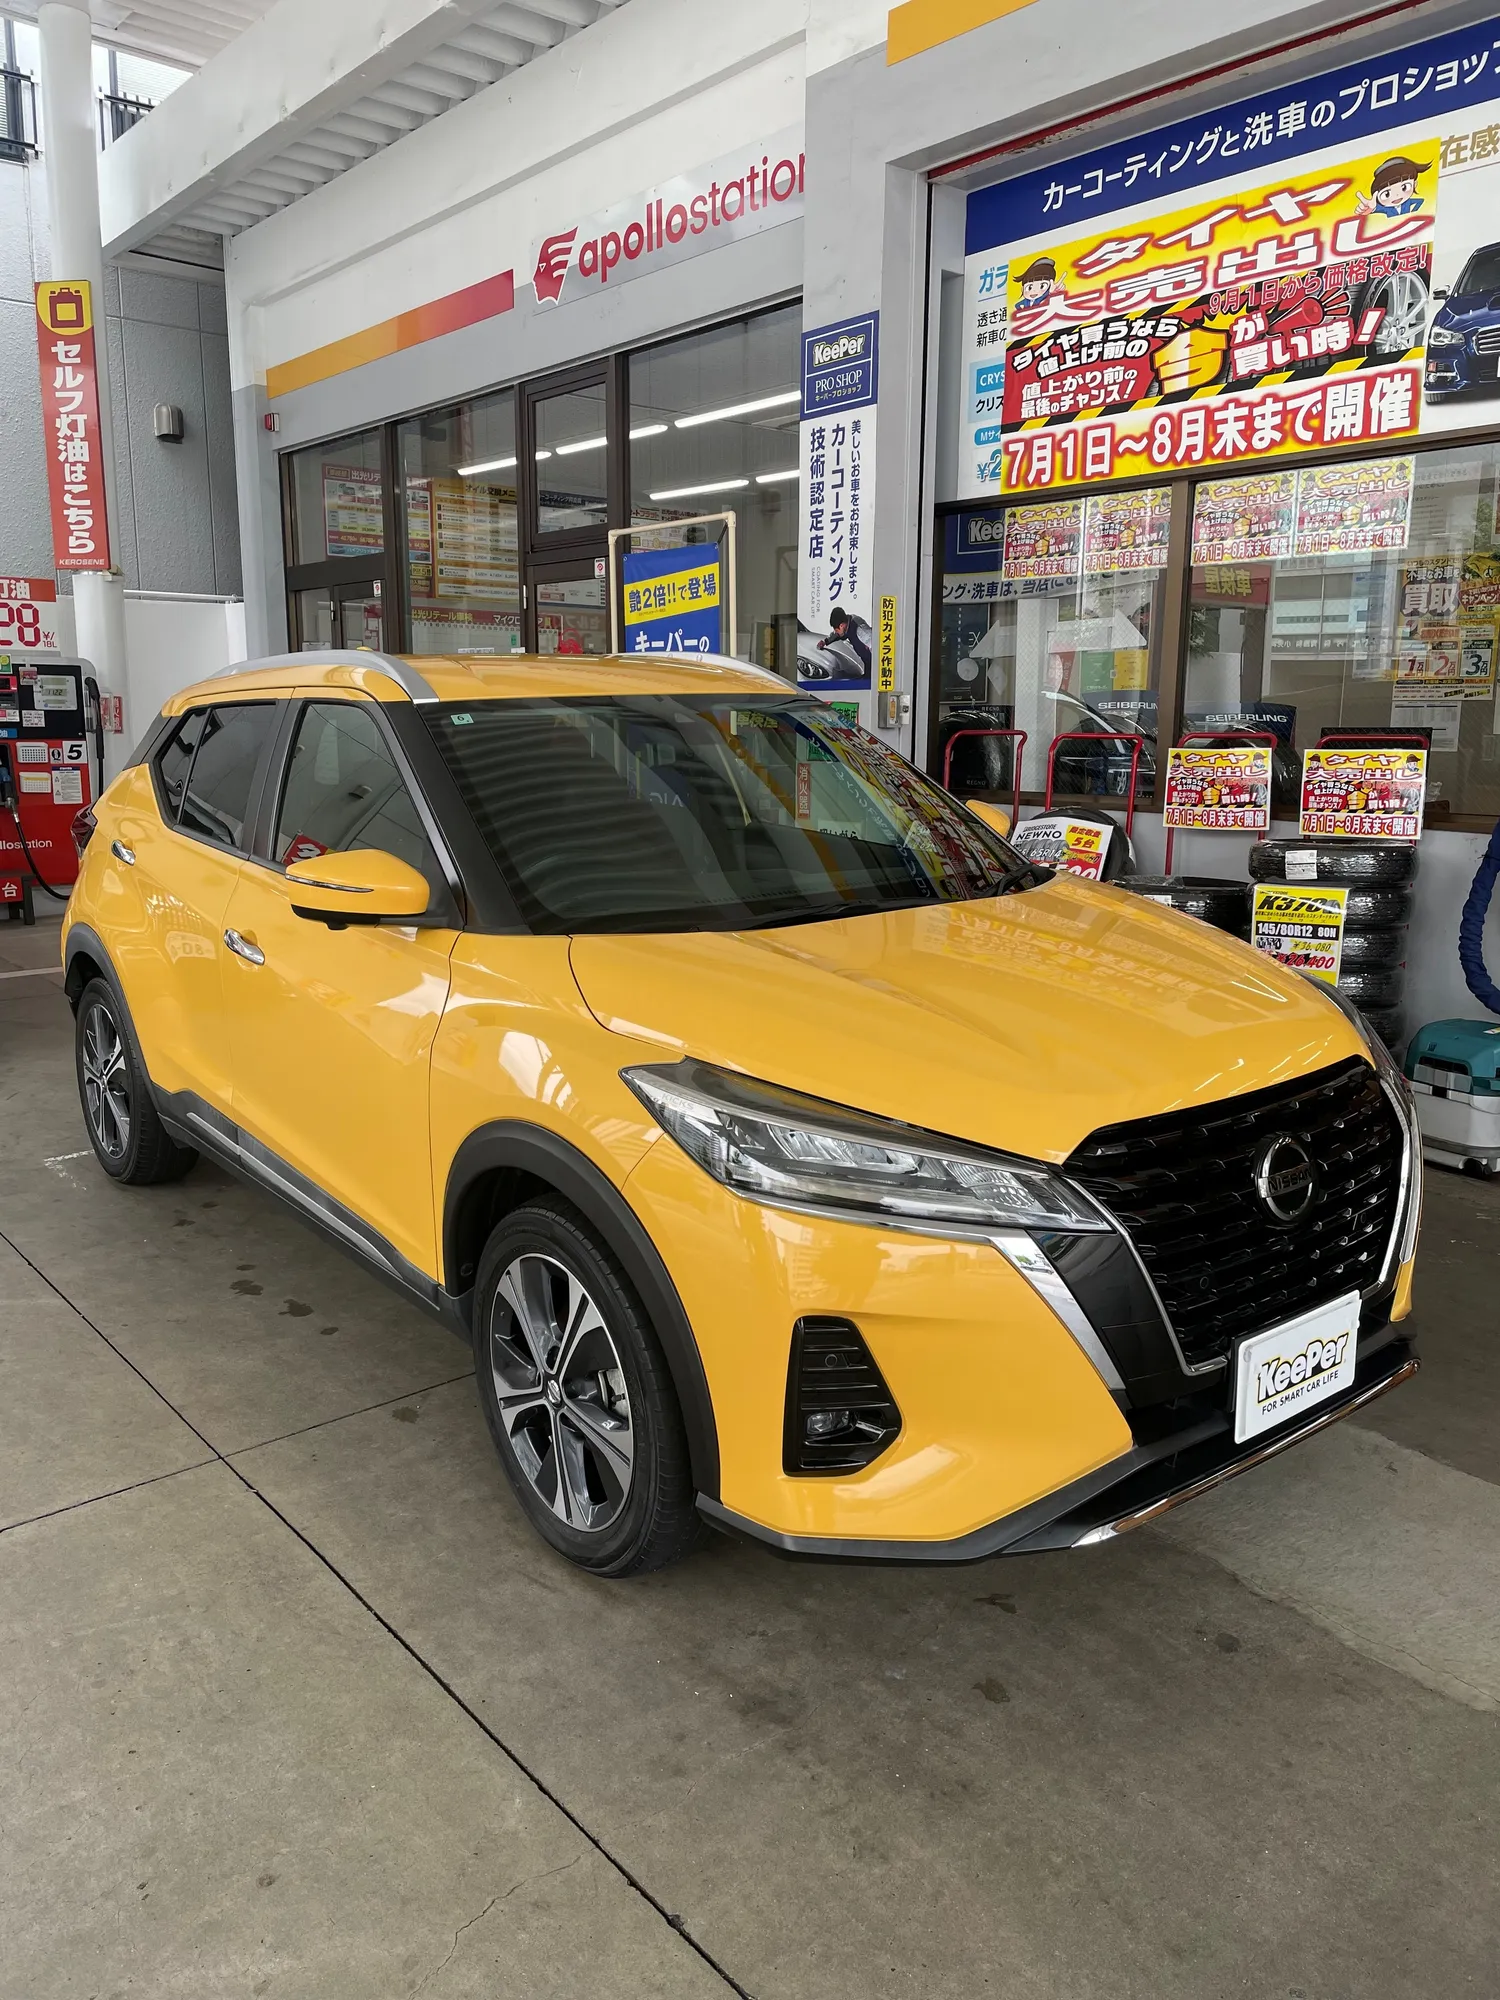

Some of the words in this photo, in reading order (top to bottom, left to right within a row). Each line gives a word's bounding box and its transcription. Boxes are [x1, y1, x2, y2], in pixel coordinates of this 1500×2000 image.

[578, 152, 805, 284] apollostatio
[1079, 180, 1348, 276] タイヤ
[1014, 216, 1432, 334] 大売出し
[1233, 312, 1265, 343] が
[813, 334, 866, 367] KeePer
[1012, 318, 1179, 370] タイヤ買うなら
[1233, 309, 1382, 377] 買い時!
[1038, 339, 1148, 377] 値上げ前の
[1154, 326, 1228, 393] 今
[815, 377, 834, 394] PRO
[836, 369, 862, 388] SHOP
[1022, 365, 1137, 400] 値上がり前の
[1021, 381, 1136, 419] 最後のチャンス!
[51, 340, 95, 555] セルフ灯油はこちら
[1320, 465, 1392, 483] タイヤ
[809, 426, 825, 559] 技術認定店
[1214, 480, 1277, 496] タイヤ
[1301, 479, 1410, 499] 大売出し
[829, 424, 846, 601] カーコーティング
[848, 420, 862, 600] 美しいお車をお約束します。
[1020, 506, 1069, 520] タイヤ
[1090, 506, 1171, 523] 大売出し
[1103, 494, 1157, 509] タイヤ
[1197, 492, 1293, 512] 大売出し
[1007, 517, 1081, 533] 大売出し
[58, 558, 105, 567] KEROSENE
[629, 573, 717, 613] 艶2倍!!で登場
[1403, 583, 1458, 615] 買取
[635, 628, 709, 653] キーパーの
[881, 598, 894, 690] 防犯カメラ作動中
[67, 744, 83, 760] 5
[1185, 753, 1249, 764] タイヤ
[1325, 754, 1401, 766] タイヤ
[1170, 766, 1268, 777] 大売出し
[1306, 768, 1422, 780] 大売出し
[1016, 830, 1062, 840] NEWNO
[1072, 837, 1095, 848] 5台
[1257, 922, 1312, 937] 145/80R12
[1318, 927, 1336, 938] 80N
[662, 1093, 694, 1110] KICKS
[1269, 1169, 1312, 1195] NISSAN
[1257, 1332, 1349, 1403] KeePer
[1262, 1400, 1278, 1415] FOR
[1280, 1390, 1304, 1407] SMART
[1306, 1382, 1321, 1395] CAR
[1323, 1370, 1340, 1388] LIFE
